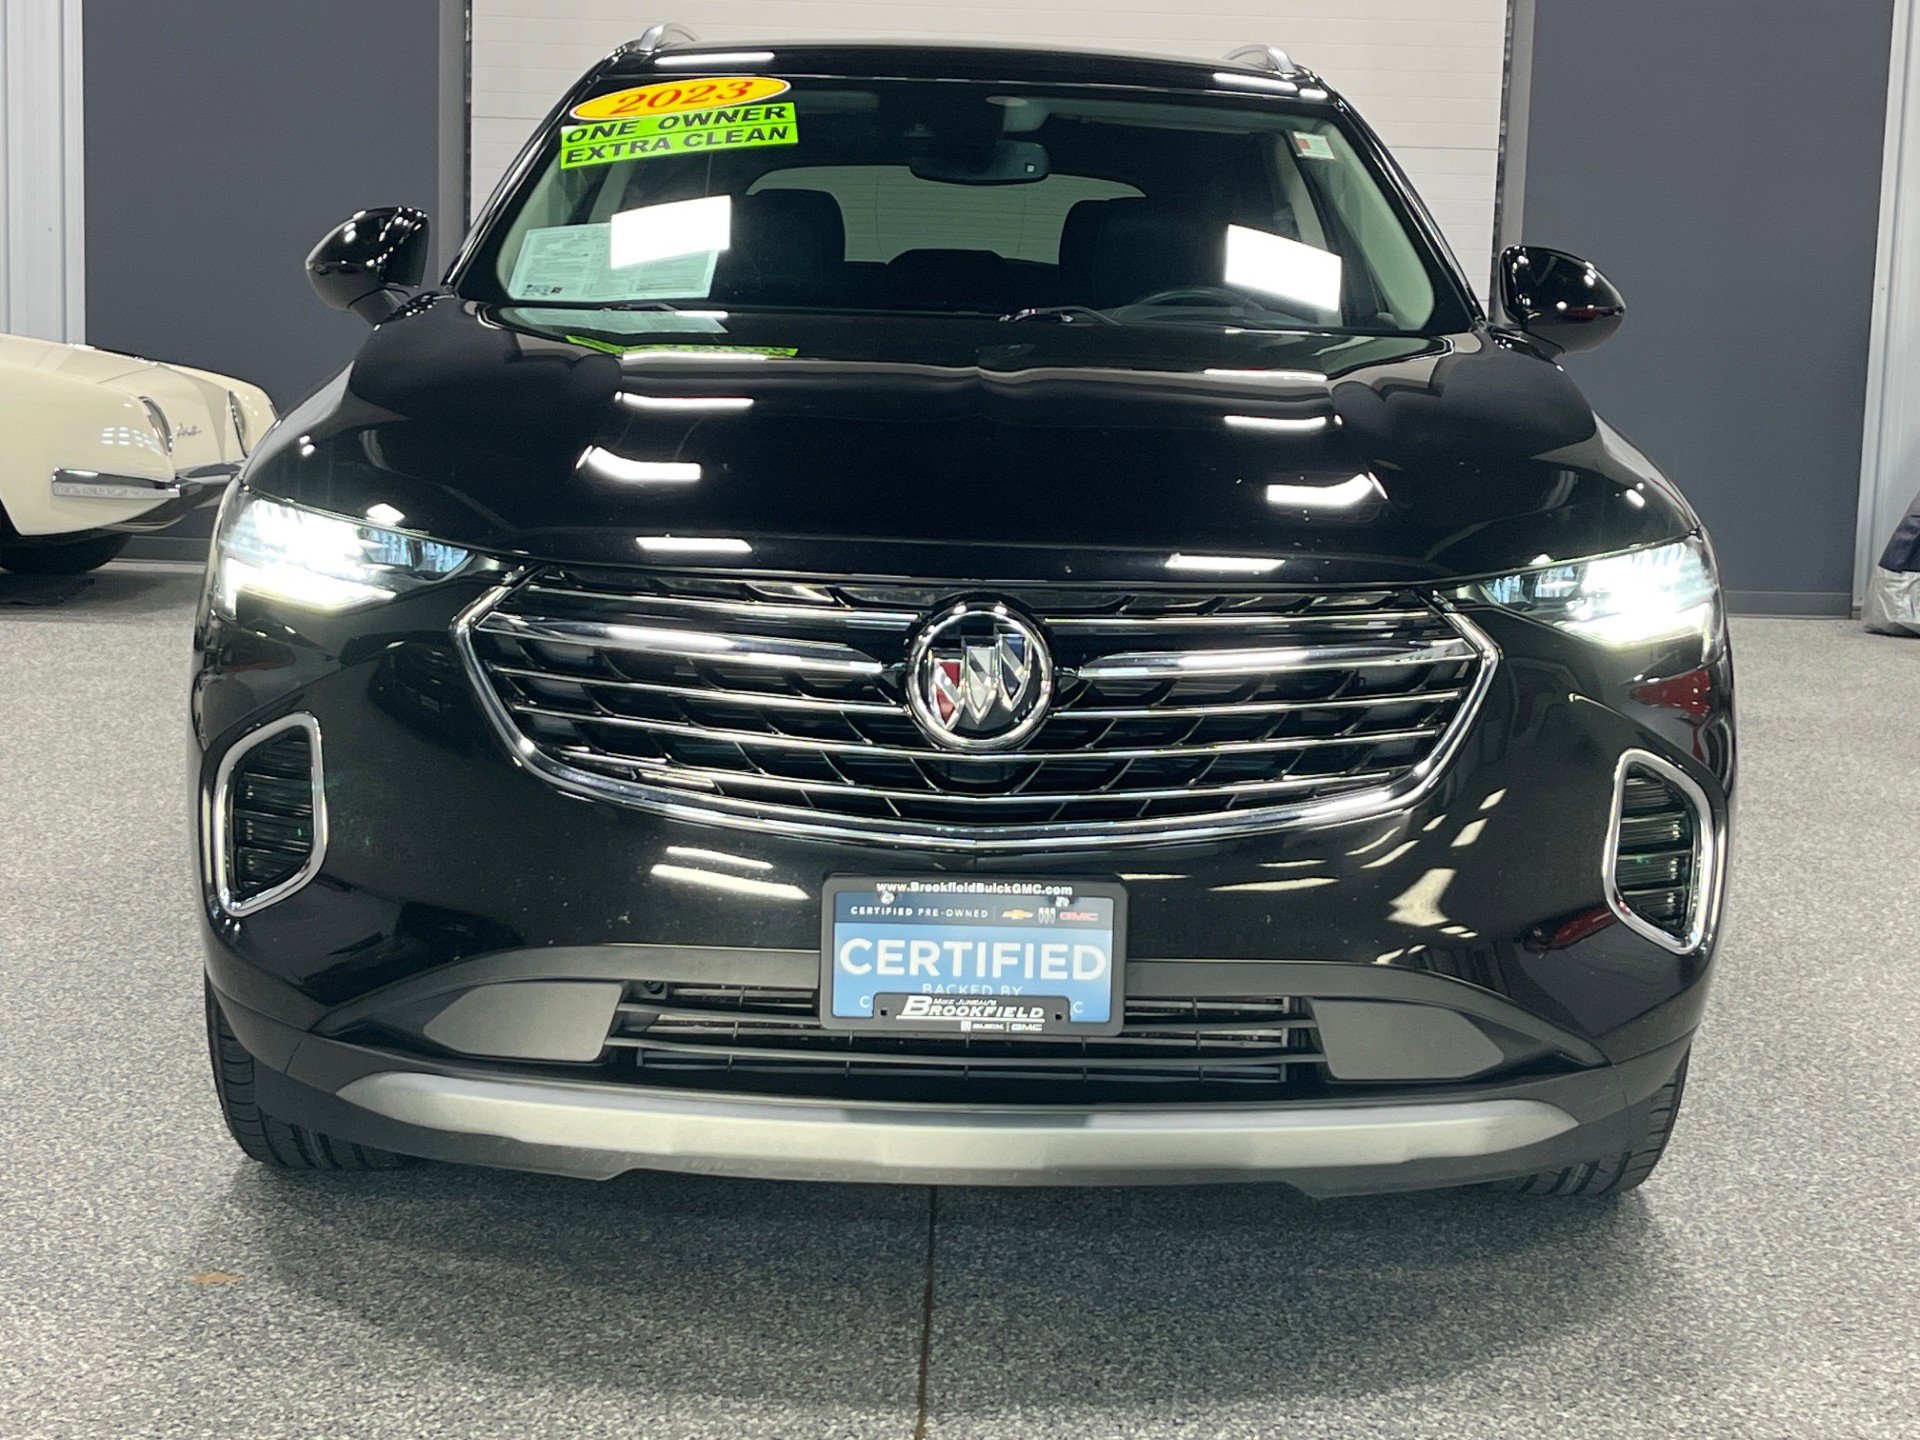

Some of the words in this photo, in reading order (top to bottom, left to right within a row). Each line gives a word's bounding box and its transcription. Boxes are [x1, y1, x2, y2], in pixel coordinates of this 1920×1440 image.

[610, 81, 754, 115] 2023
[565, 119, 640, 145] ONE
[656, 105, 787, 130] OWNER
[564, 136, 672, 164] EXTRA
[683, 125, 789, 148] CLEAN
[876, 881, 1073, 896] www.BrookfieldBuickGMC.com
[850, 905, 914, 917] CERTIFIED
[917, 907, 989, 919] PRE-OWNED
[1059, 911, 1099, 922] GMC
[839, 937, 1107, 981] CERTIFIED
[922, 983, 993, 996] BACKED
[1000, 985, 1023, 997] BY
[1011, 1023, 1043, 1032] GMC
